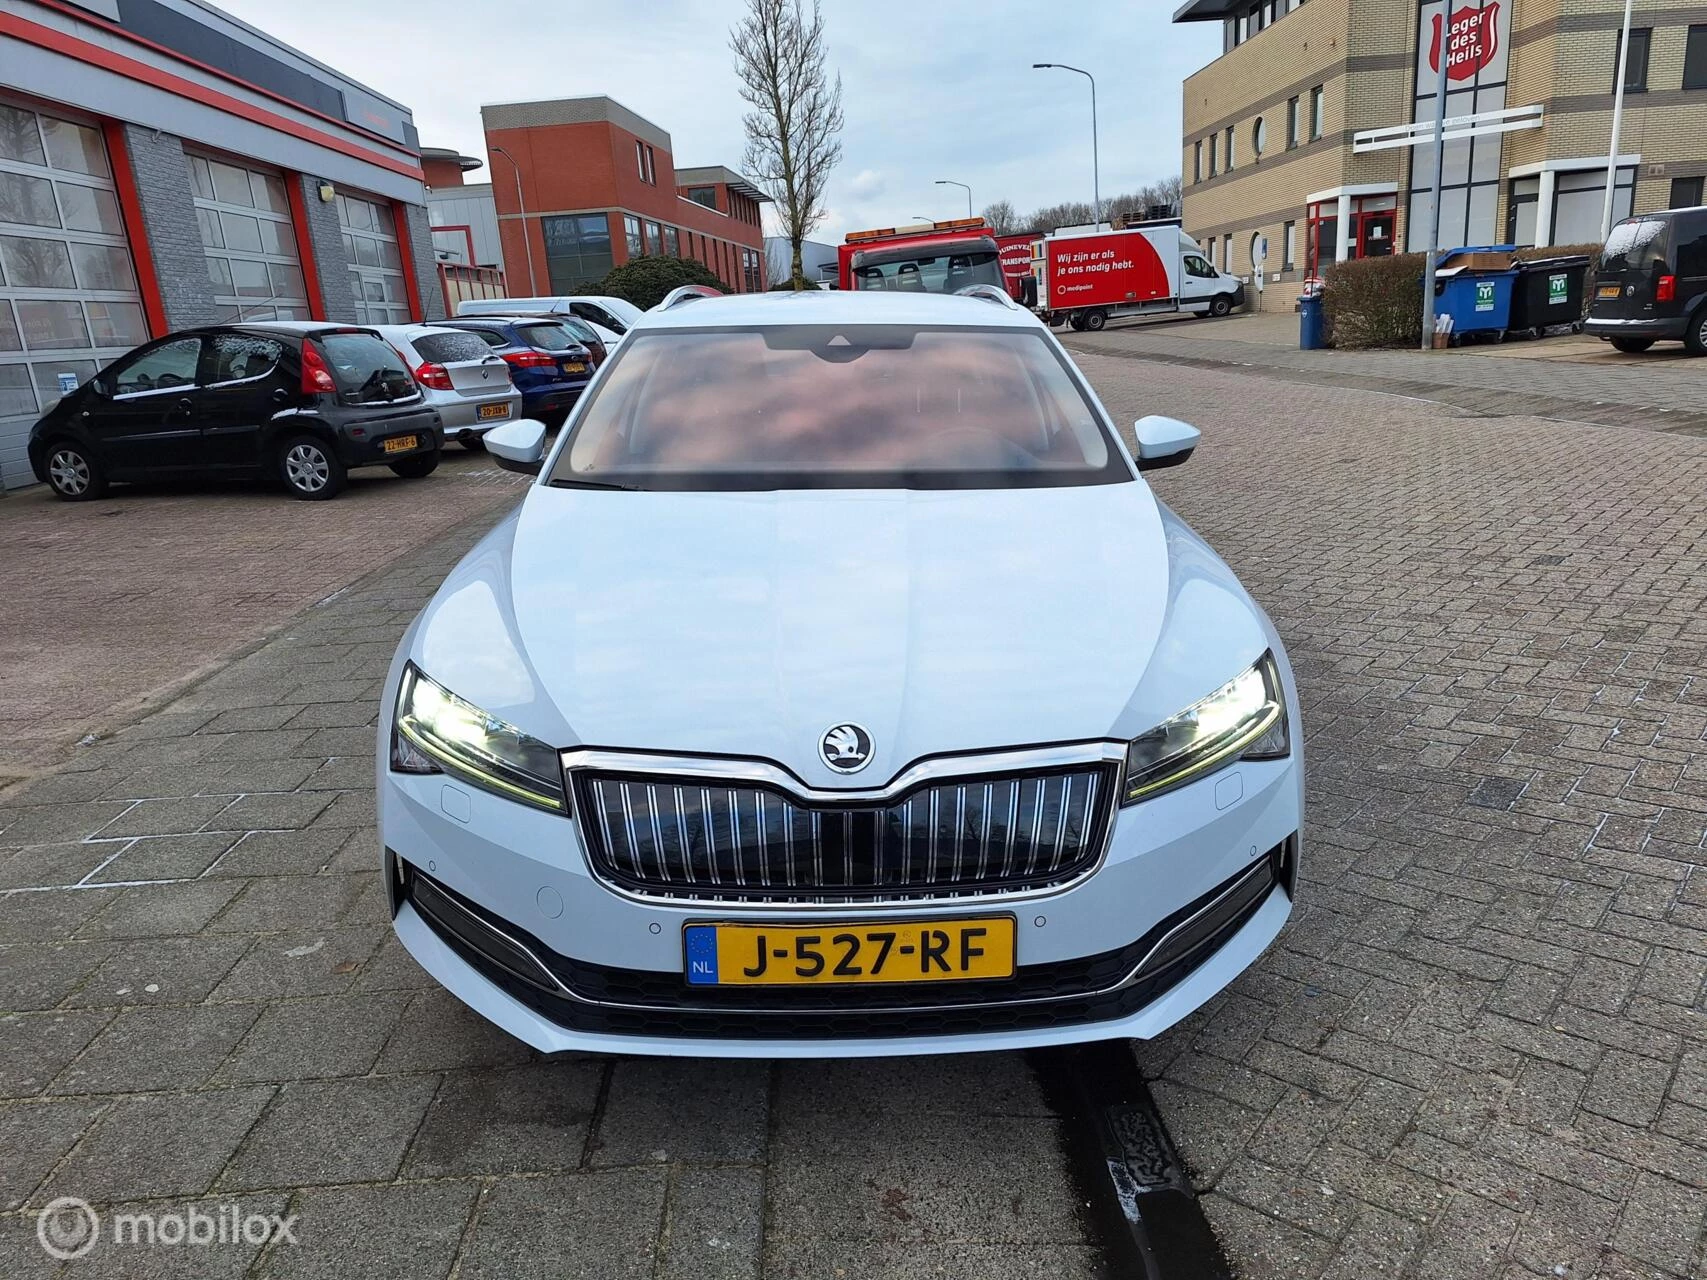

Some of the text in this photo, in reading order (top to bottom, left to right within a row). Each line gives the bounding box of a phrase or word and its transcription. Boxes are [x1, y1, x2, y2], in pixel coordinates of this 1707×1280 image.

[1446, 11, 1486, 37] Leger
[1451, 31, 1477, 50] des
[1446, 44, 1483, 68] Heils
[1057, 249, 1115, 264] Wij zijn er als
[1057, 259, 1135, 277] je ons nodig hebt.
[1066, 284, 1094, 292] medipoint
[744, 927, 987, 978] J-527-RF
[693, 961, 713, 974] NL
